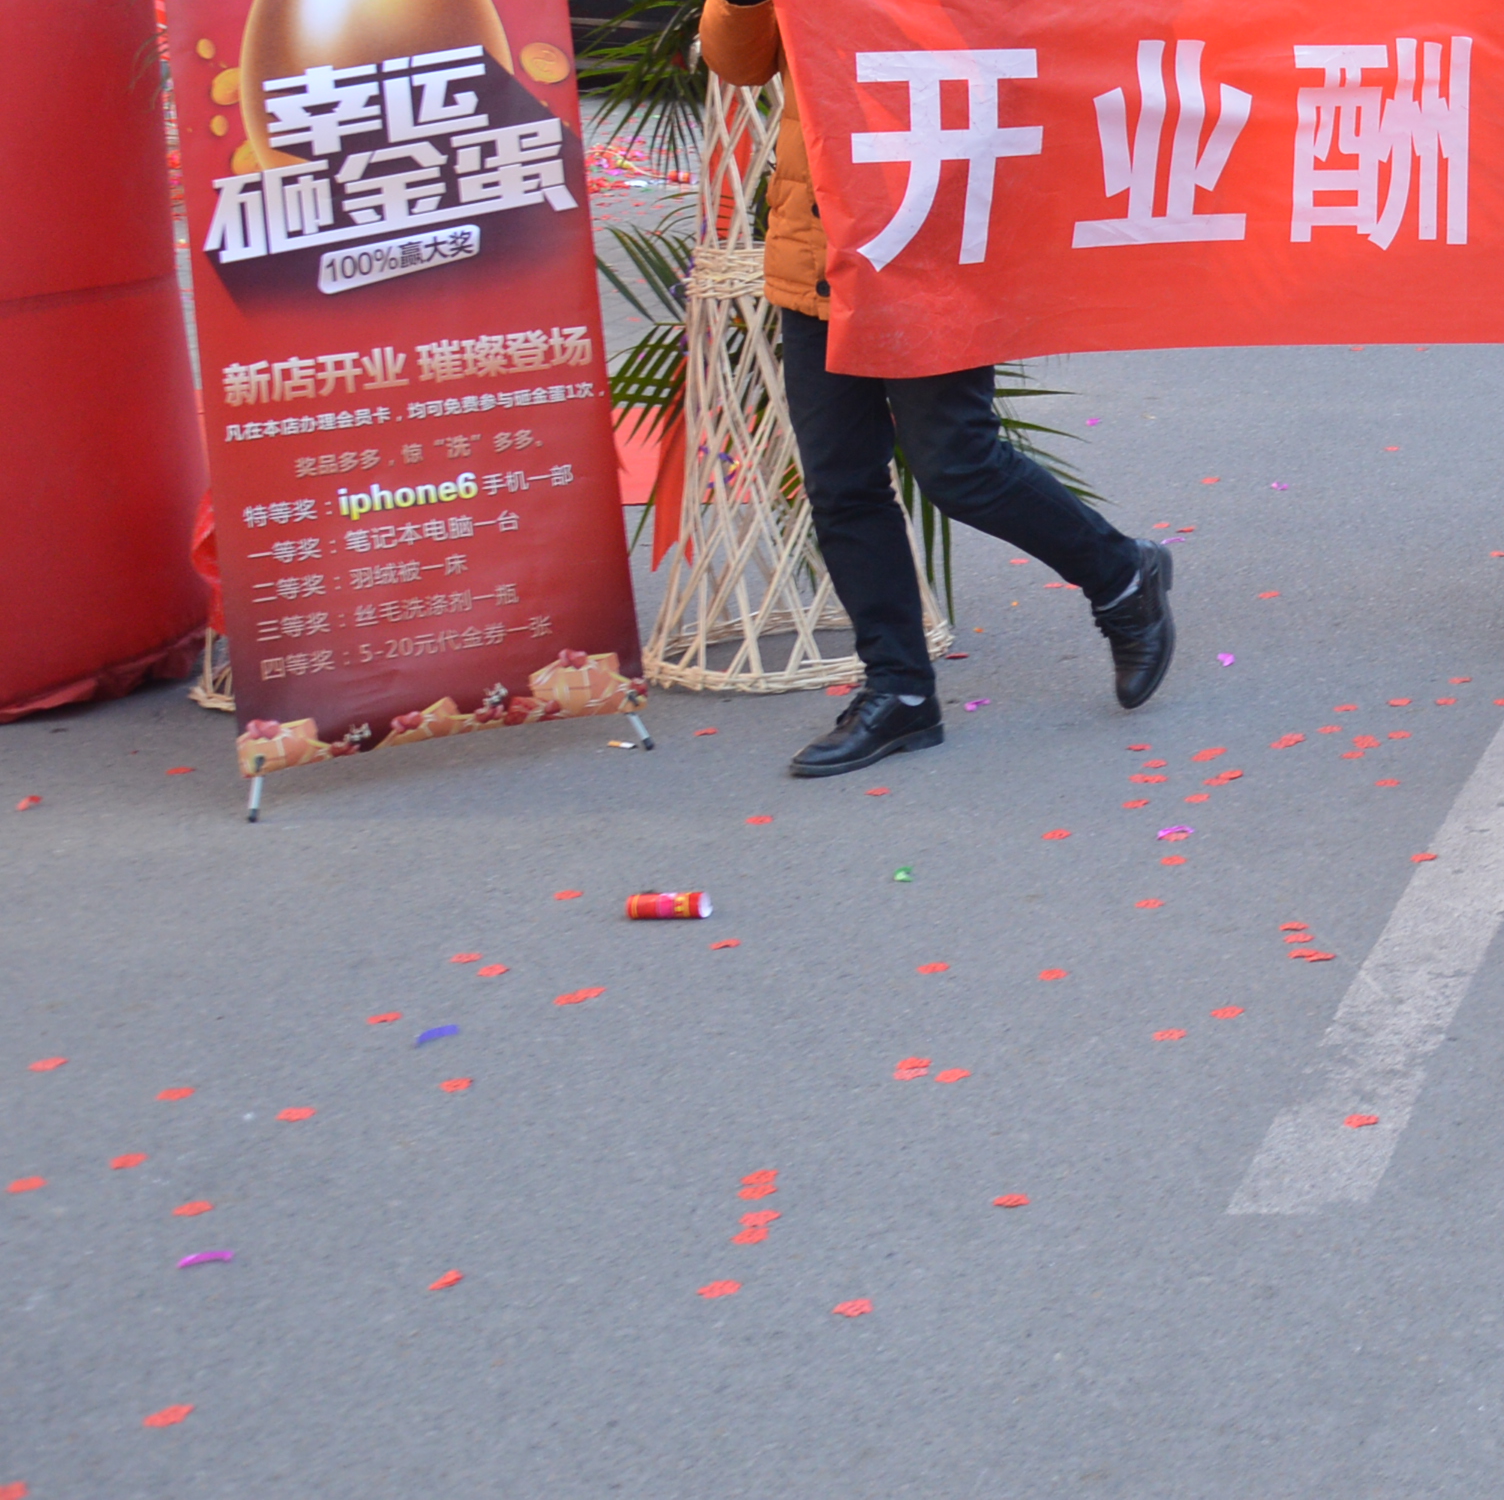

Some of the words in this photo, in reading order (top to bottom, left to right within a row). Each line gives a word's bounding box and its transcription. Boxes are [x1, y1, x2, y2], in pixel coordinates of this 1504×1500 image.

[263, 44, 489, 156] 幸运
[203, 117, 580, 264] 砸金蛋
[325, 230, 475, 284] 100%赢大奖
[222, 346, 409, 408] 新店开业
[415, 325, 593, 384] 璀璨登场
[337, 471, 479, 521] iphone6
